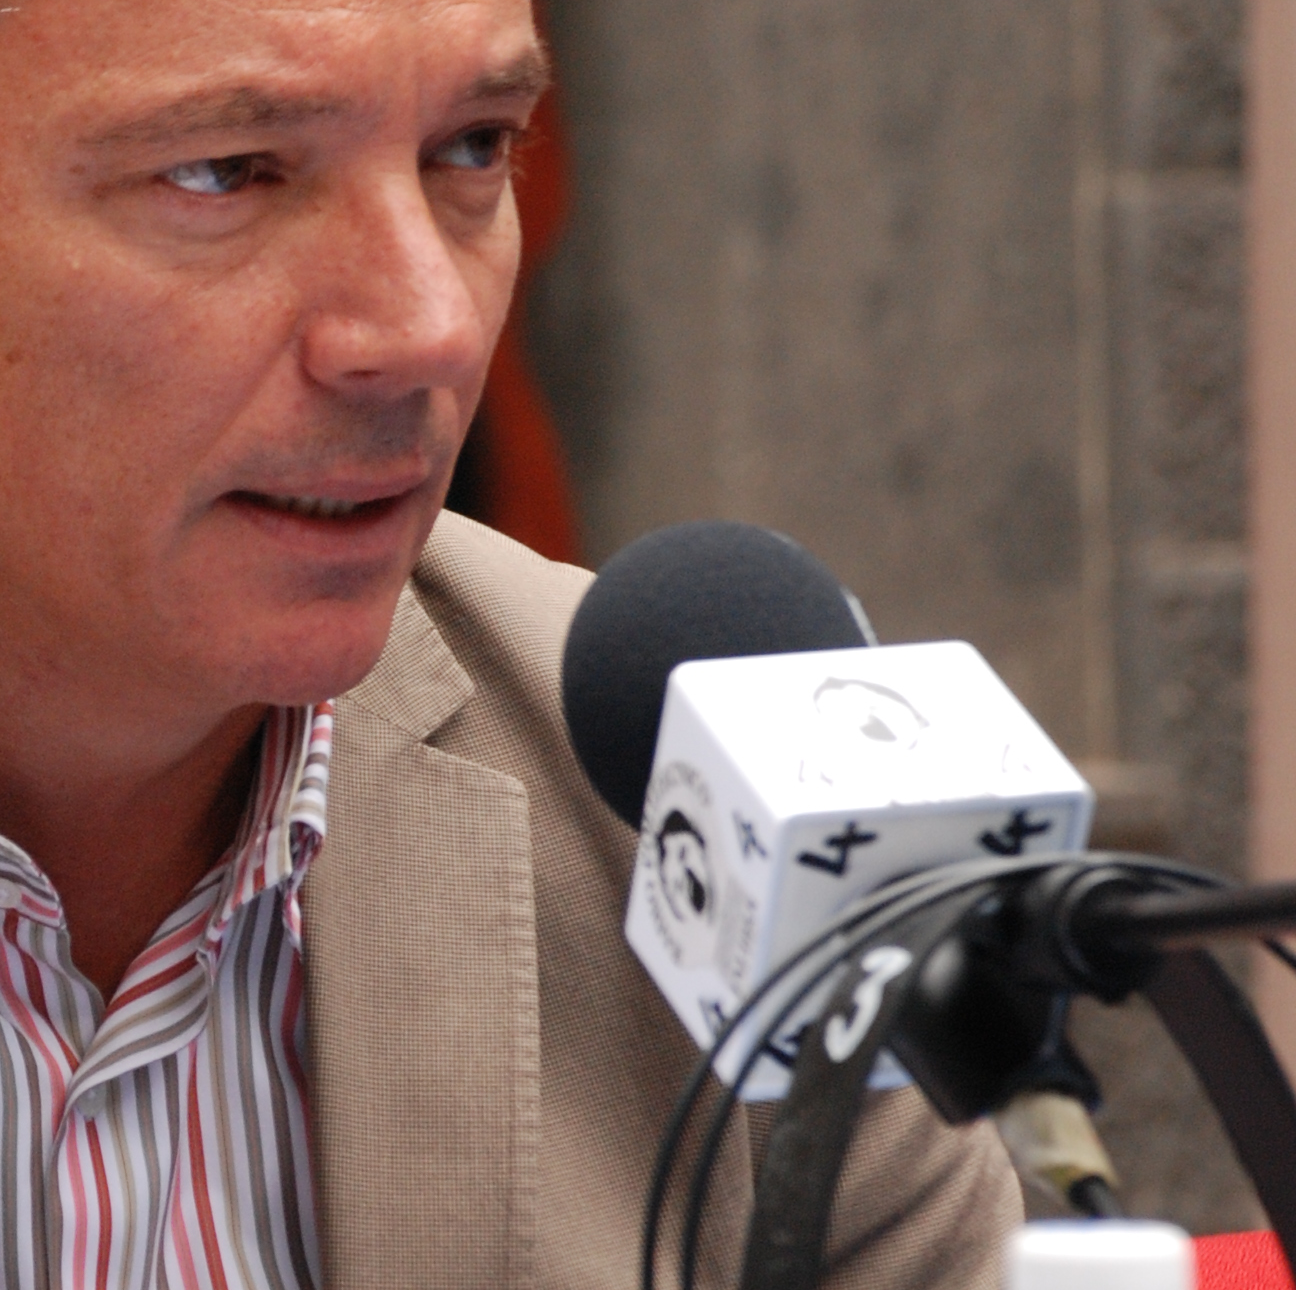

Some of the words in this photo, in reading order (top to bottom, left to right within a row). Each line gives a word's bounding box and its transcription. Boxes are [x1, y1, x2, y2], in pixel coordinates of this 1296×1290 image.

[796, 820, 879, 877] 4
[976, 806, 1053, 857] 4
[823, 945, 913, 1063] 3
